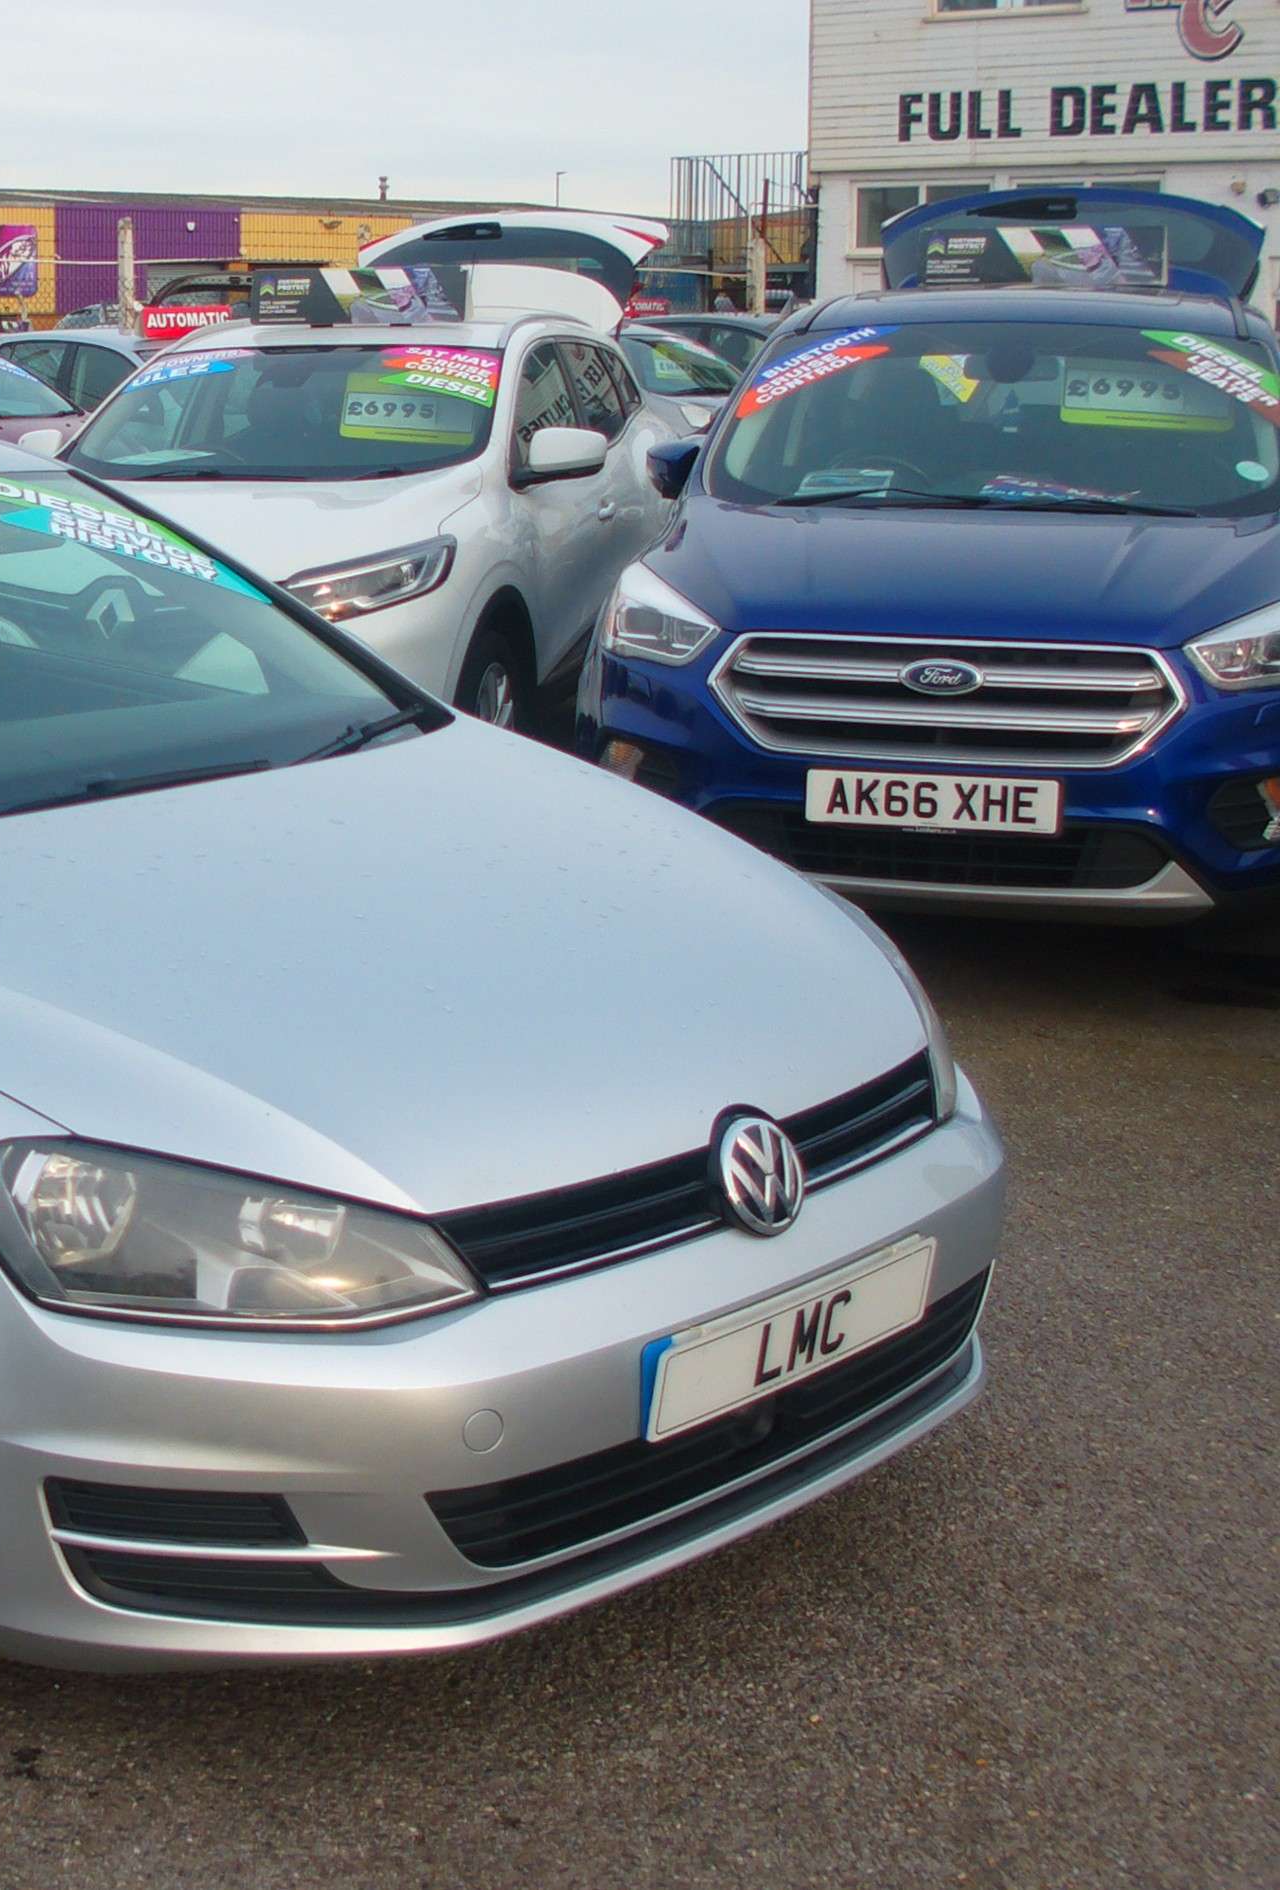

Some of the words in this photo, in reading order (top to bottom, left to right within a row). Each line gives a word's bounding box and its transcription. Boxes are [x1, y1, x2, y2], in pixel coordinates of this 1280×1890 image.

[898, 89, 1022, 142] FULL
[1049, 78, 1278, 136] DEALER
[147, 312, 230, 328] AUTOMATIC
[405, 346, 450, 358] SAT
[450, 353, 497, 368] NAV
[405, 361, 491, 387] CONTROL
[422, 358, 494, 379] CRUISE
[756, 352, 844, 394] CRUISE
[761, 327, 878, 379] BLUETOOTH
[1172, 335, 1264, 384] DIESEL
[405, 373, 489, 401] DIESEL
[755, 354, 862, 405] CONTROL
[1067, 378, 1181, 401] £6995
[1186, 355, 1280, 406] LEATHER
[1186, 364, 1257, 403] SEATS
[348, 401, 436, 419] £6995
[50, 521, 217, 581] HISTORY
[51, 510, 212, 570] SERVICE
[920, 666, 962, 685] Ford
[826, 777, 939, 819] AK66
[952, 783, 1039, 825] XHE
[754, 1289, 852, 1387] LMC
